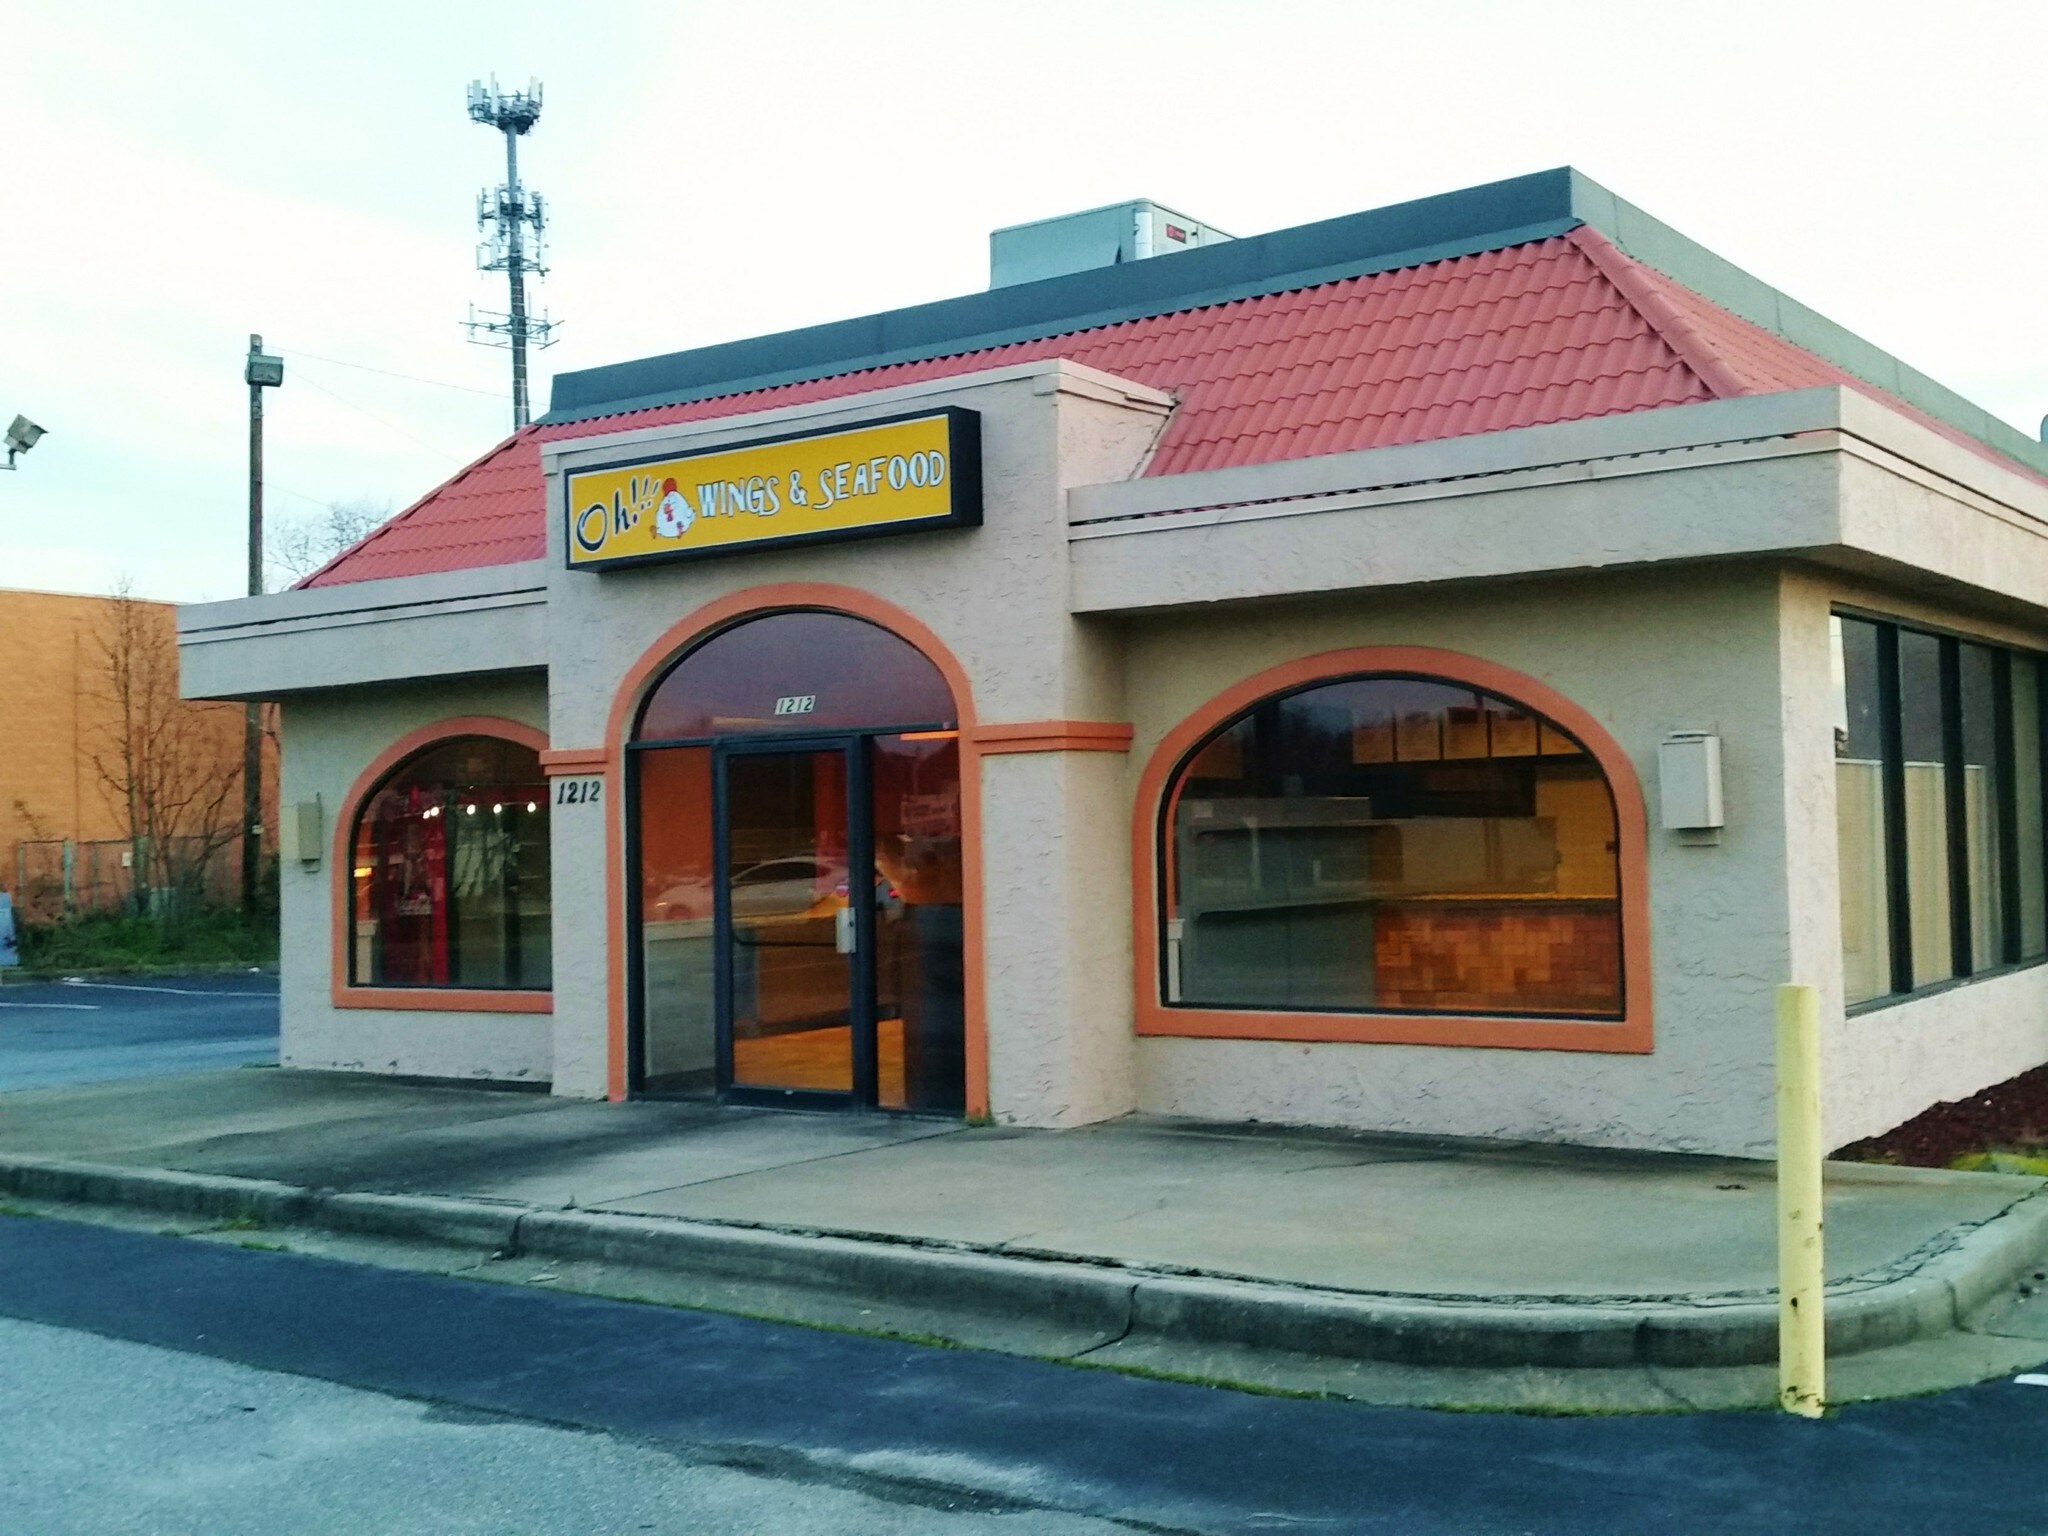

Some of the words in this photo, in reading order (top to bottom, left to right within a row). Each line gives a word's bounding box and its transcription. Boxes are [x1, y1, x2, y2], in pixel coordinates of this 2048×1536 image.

[575, 476, 661, 553] Oh!!!
[696, 475, 780, 517] WINGS
[788, 469, 808, 507] &
[812, 449, 946, 510] SEAFOOD
[778, 697, 813, 713] 1212
[556, 780, 601, 805] 1212
